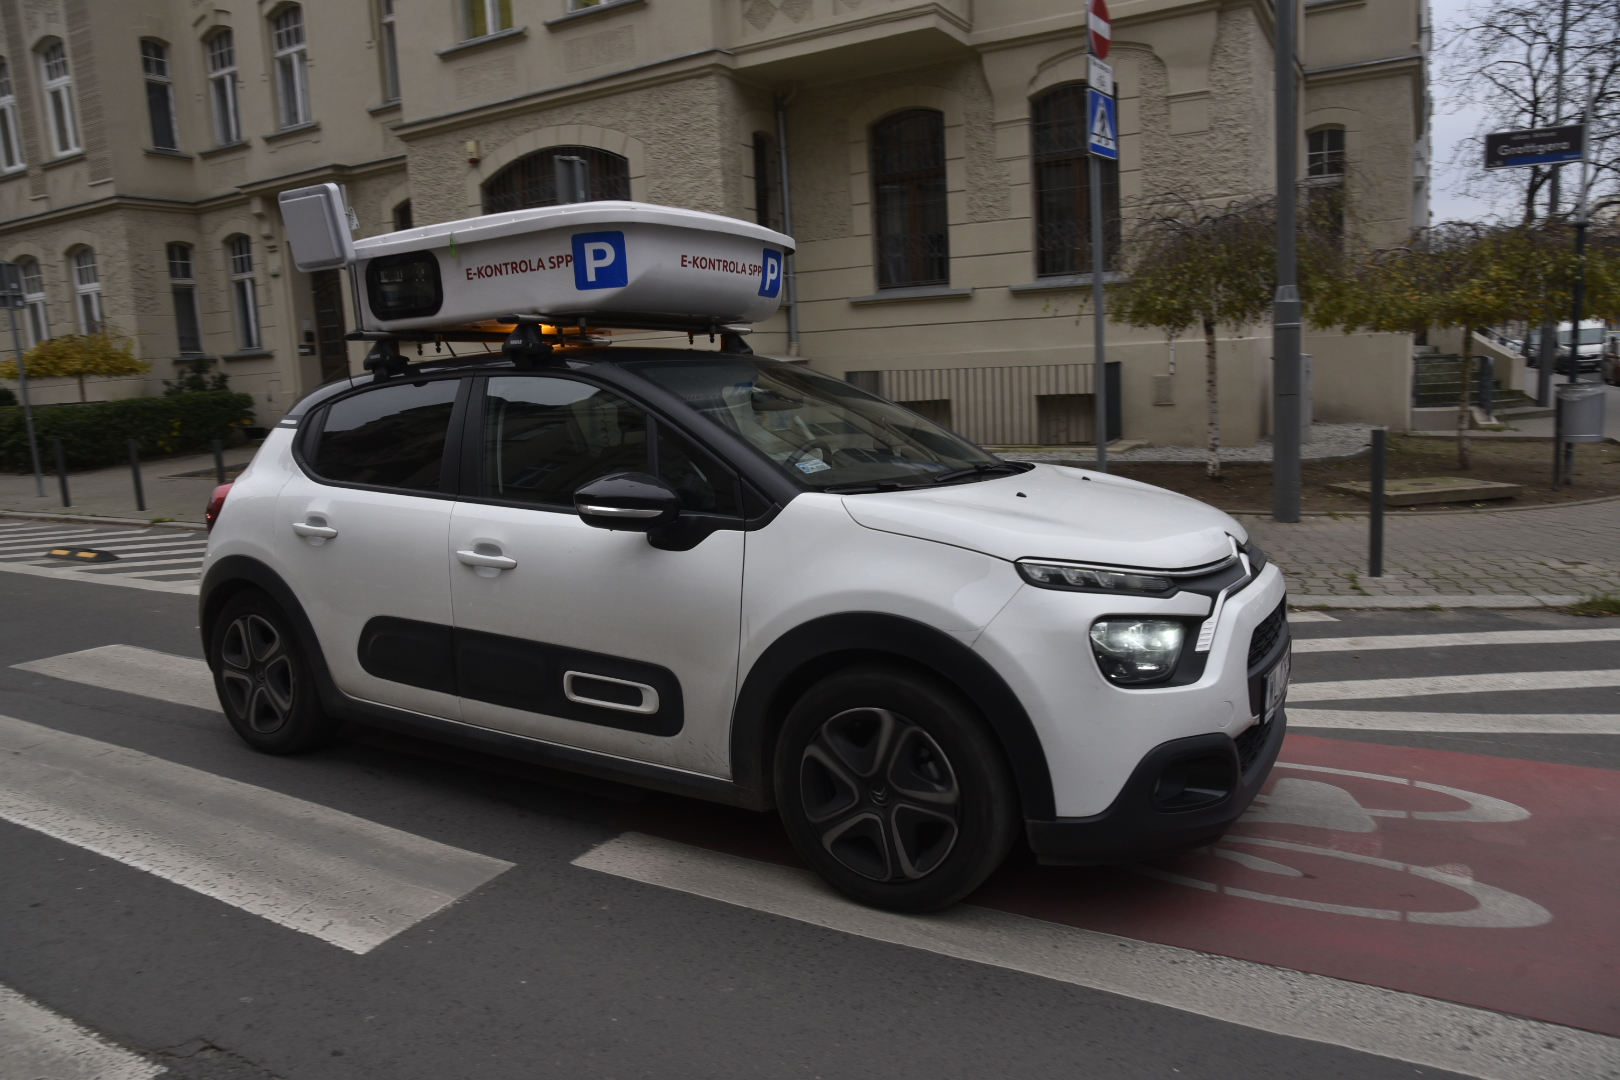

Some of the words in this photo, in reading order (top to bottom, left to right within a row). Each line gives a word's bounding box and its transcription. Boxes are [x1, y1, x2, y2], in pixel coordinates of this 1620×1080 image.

[465, 258, 546, 280] E-KONTROLA
[548, 254, 574, 270] SPP
[583, 241, 616, 282] P
[681, 254, 747, 275] E-KONTROLA
[748, 264, 763, 277] SPP
[764, 257, 778, 291] P
